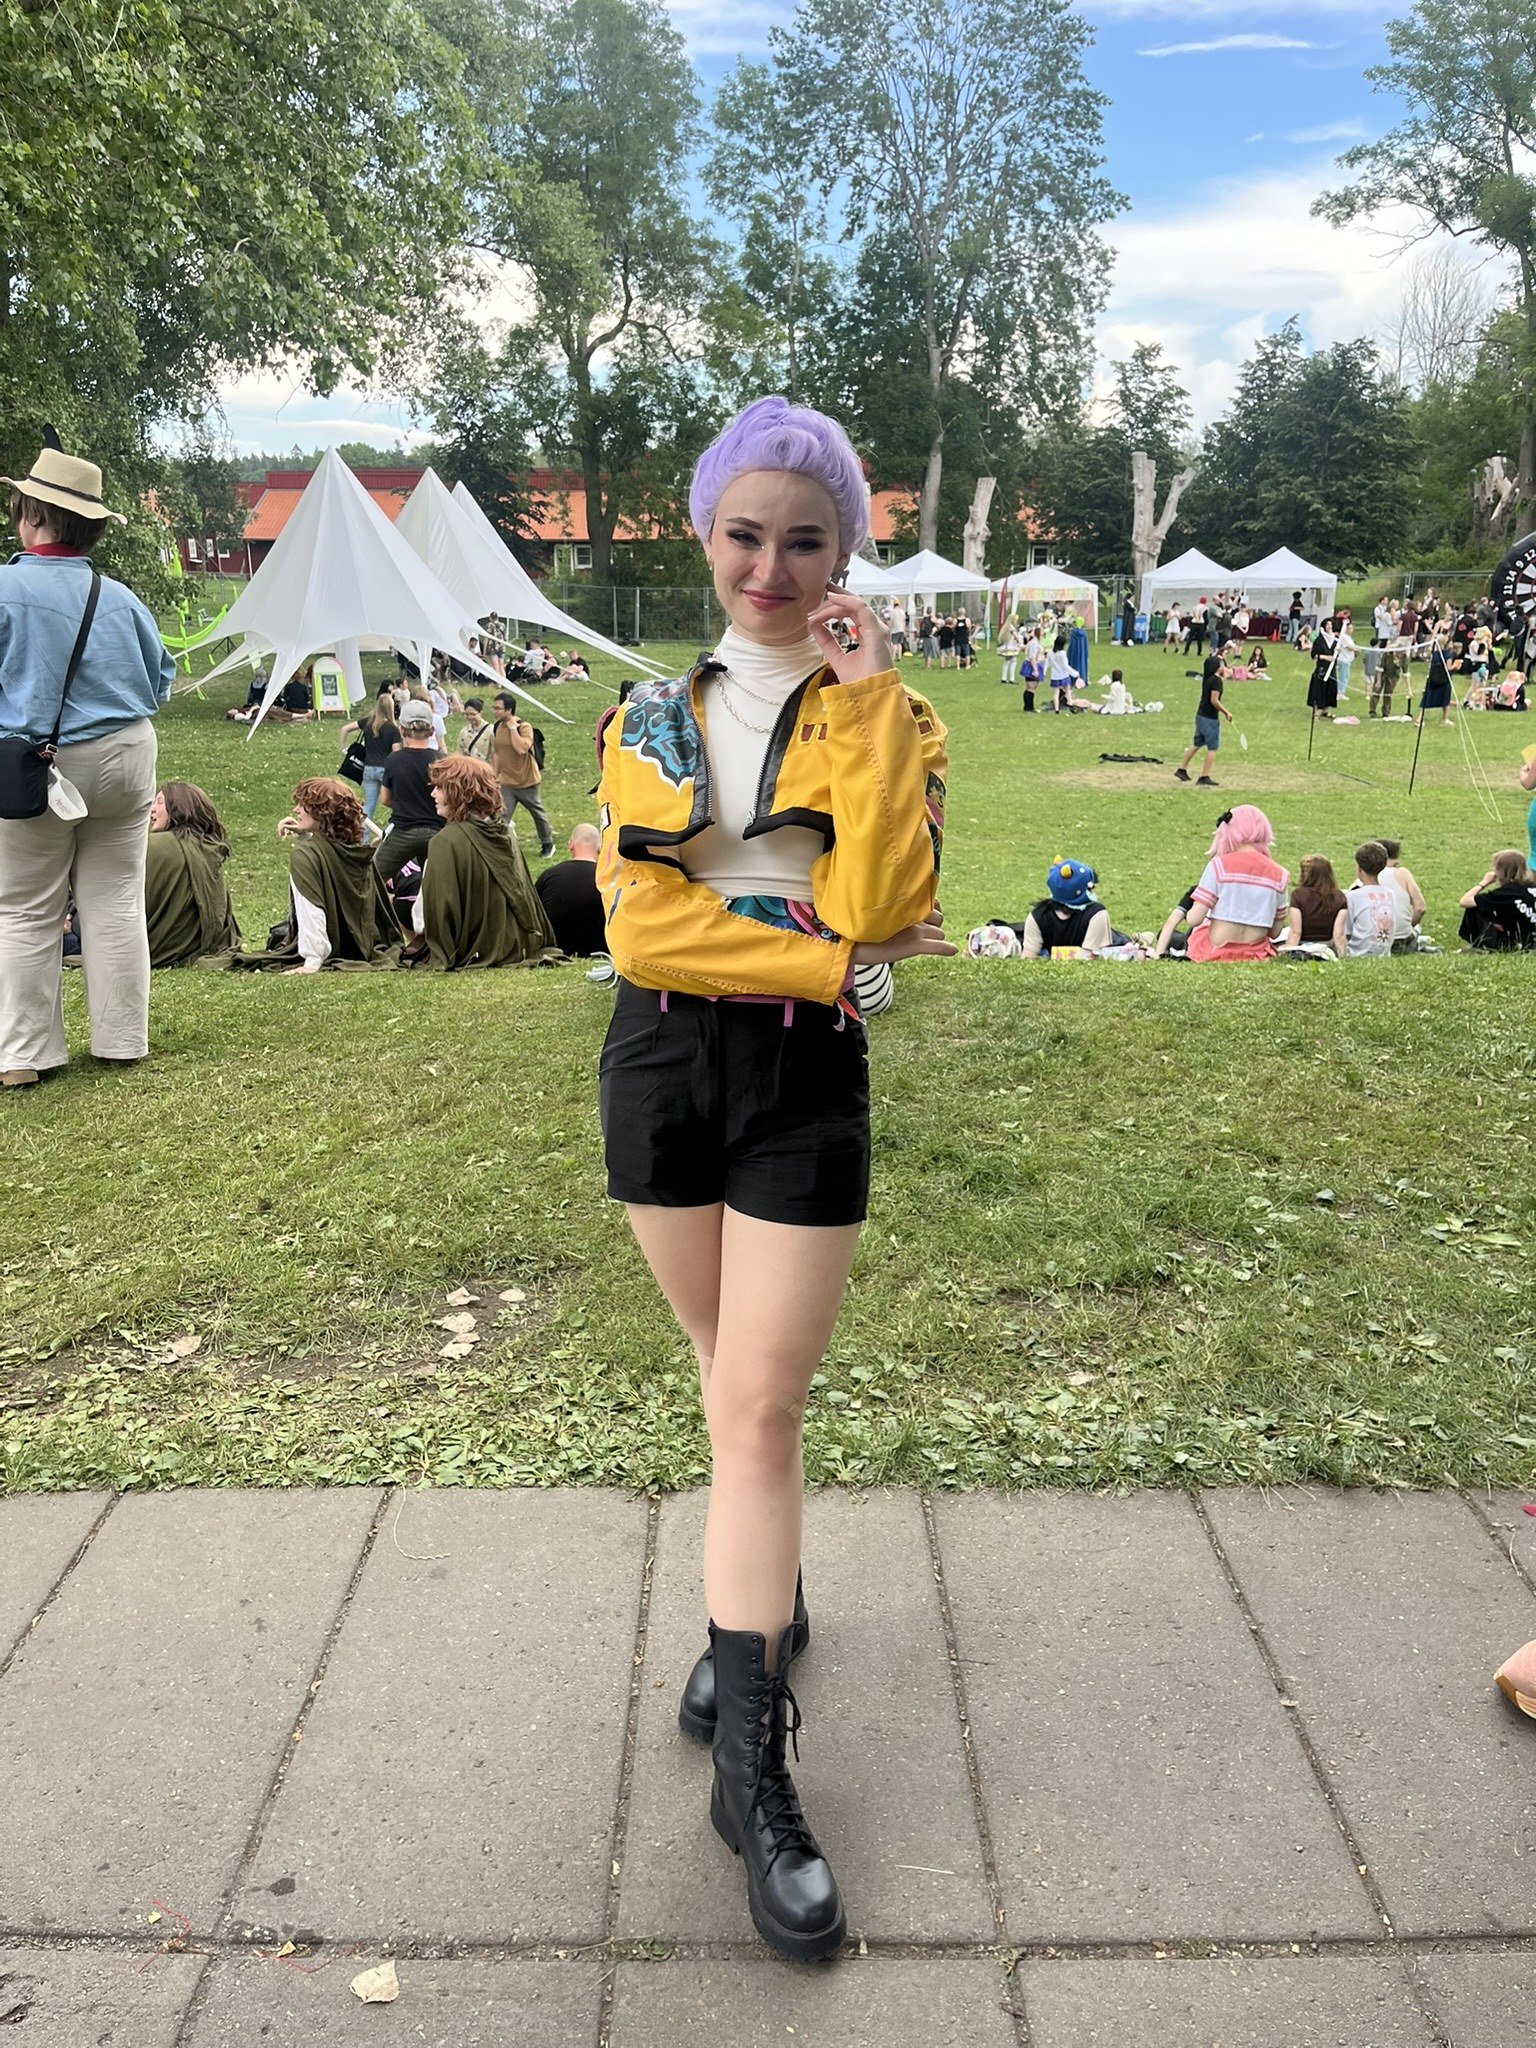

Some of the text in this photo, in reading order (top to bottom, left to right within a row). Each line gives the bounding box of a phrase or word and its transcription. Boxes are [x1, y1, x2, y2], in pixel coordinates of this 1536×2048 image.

[1515, 560, 1524, 569] 9
[1506, 570, 1517, 582] 14
[1503, 584, 1513, 595] 11
